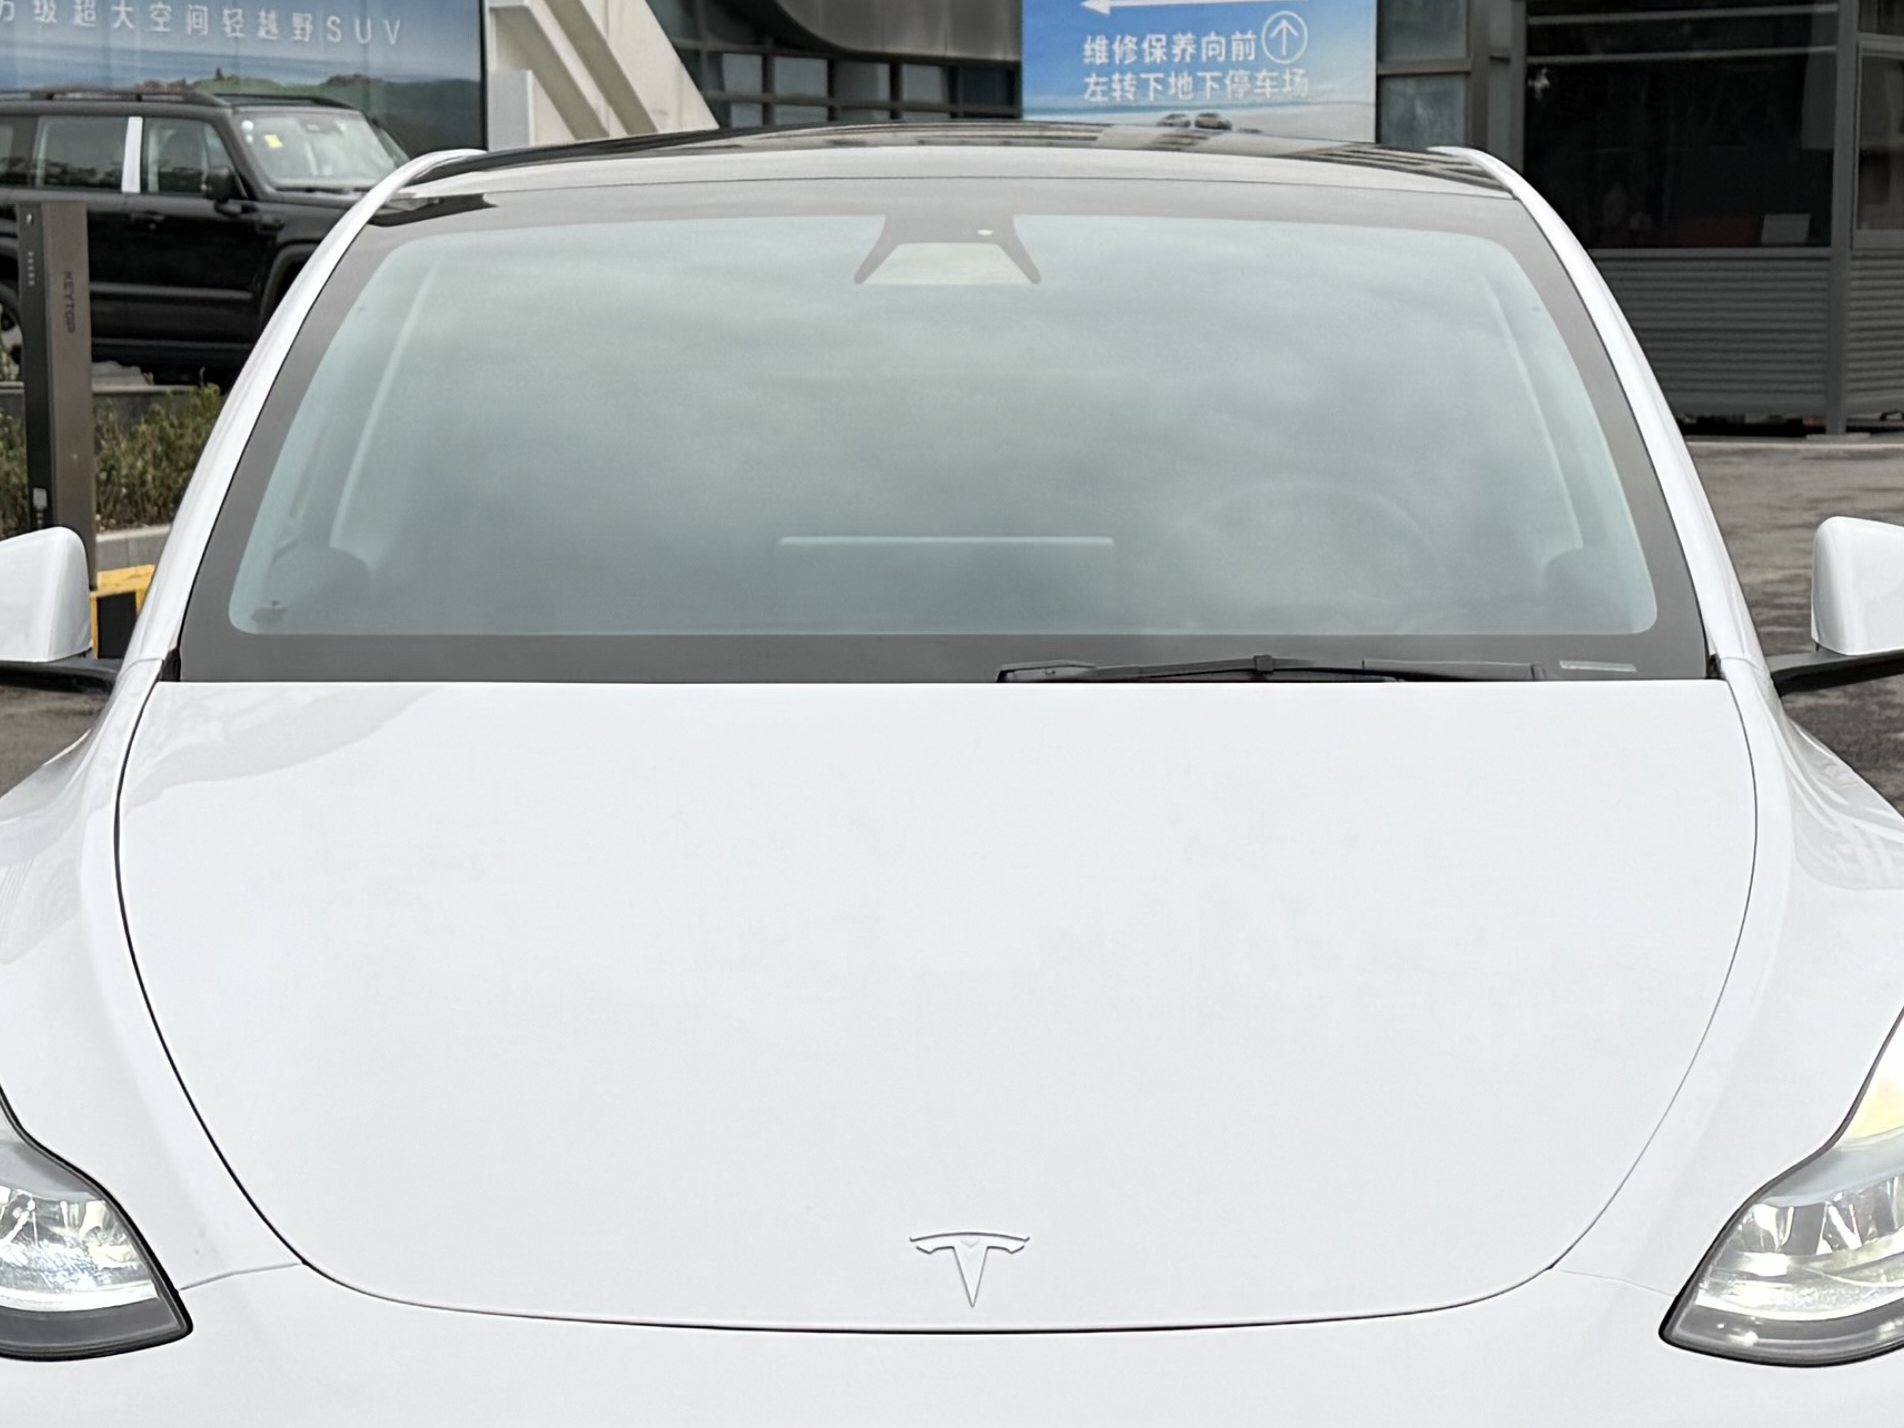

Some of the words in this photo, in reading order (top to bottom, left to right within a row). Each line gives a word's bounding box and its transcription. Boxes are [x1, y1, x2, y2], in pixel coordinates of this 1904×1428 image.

[1083, 30, 1257, 65] 维修保养向前
[1083, 68, 1310, 103] 左转下地下停车场
